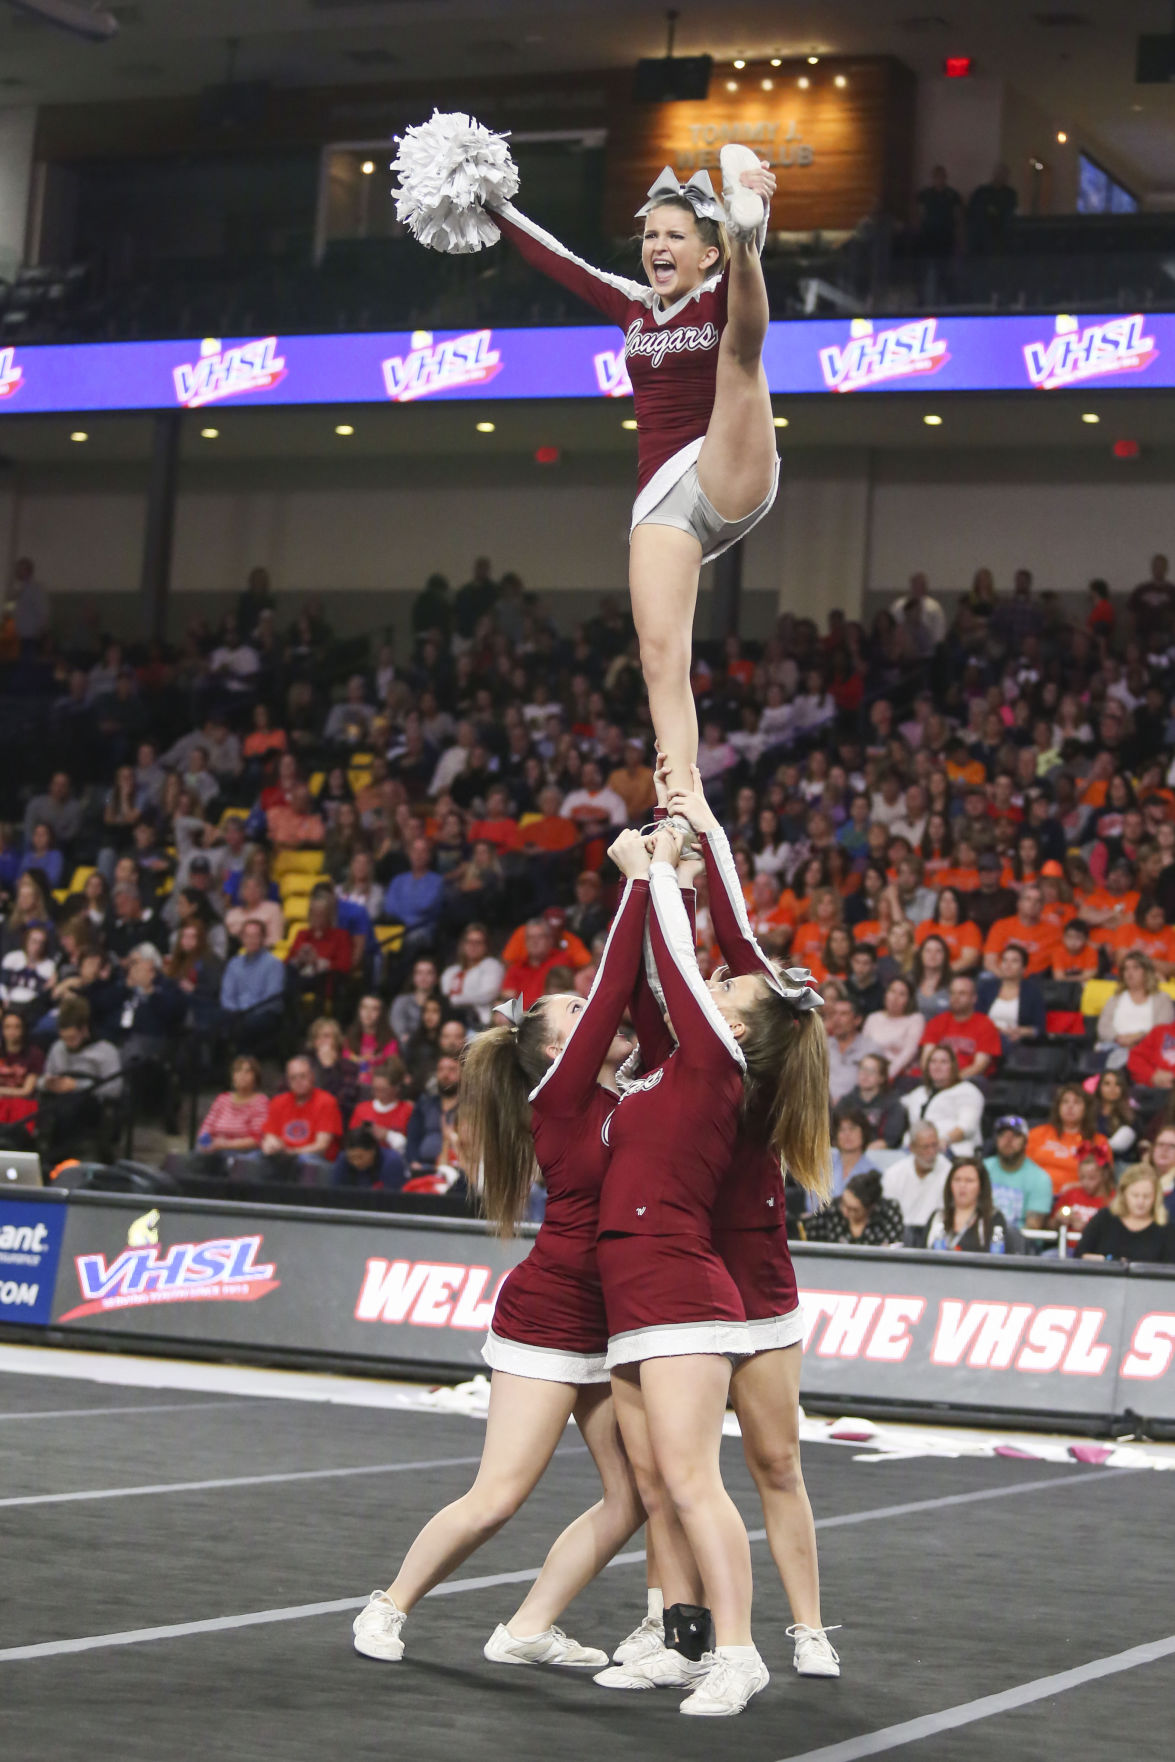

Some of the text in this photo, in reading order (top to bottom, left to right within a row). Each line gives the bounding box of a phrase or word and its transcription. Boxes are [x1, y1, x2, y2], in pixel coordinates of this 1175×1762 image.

[688, 121, 780, 144] TOMMY
[173, 336, 286, 402] VHSL
[382, 328, 500, 396] VHSL
[625, 317, 719, 369] Cougars
[820, 318, 947, 387] VHSL
[1023, 314, 1156, 383] VHSL
[0, 1280, 39, 1307] OM
[75, 1235, 276, 1300] VHSL
[798, 1288, 927, 1363] THE
[930, 1297, 1113, 1378] VHSL
